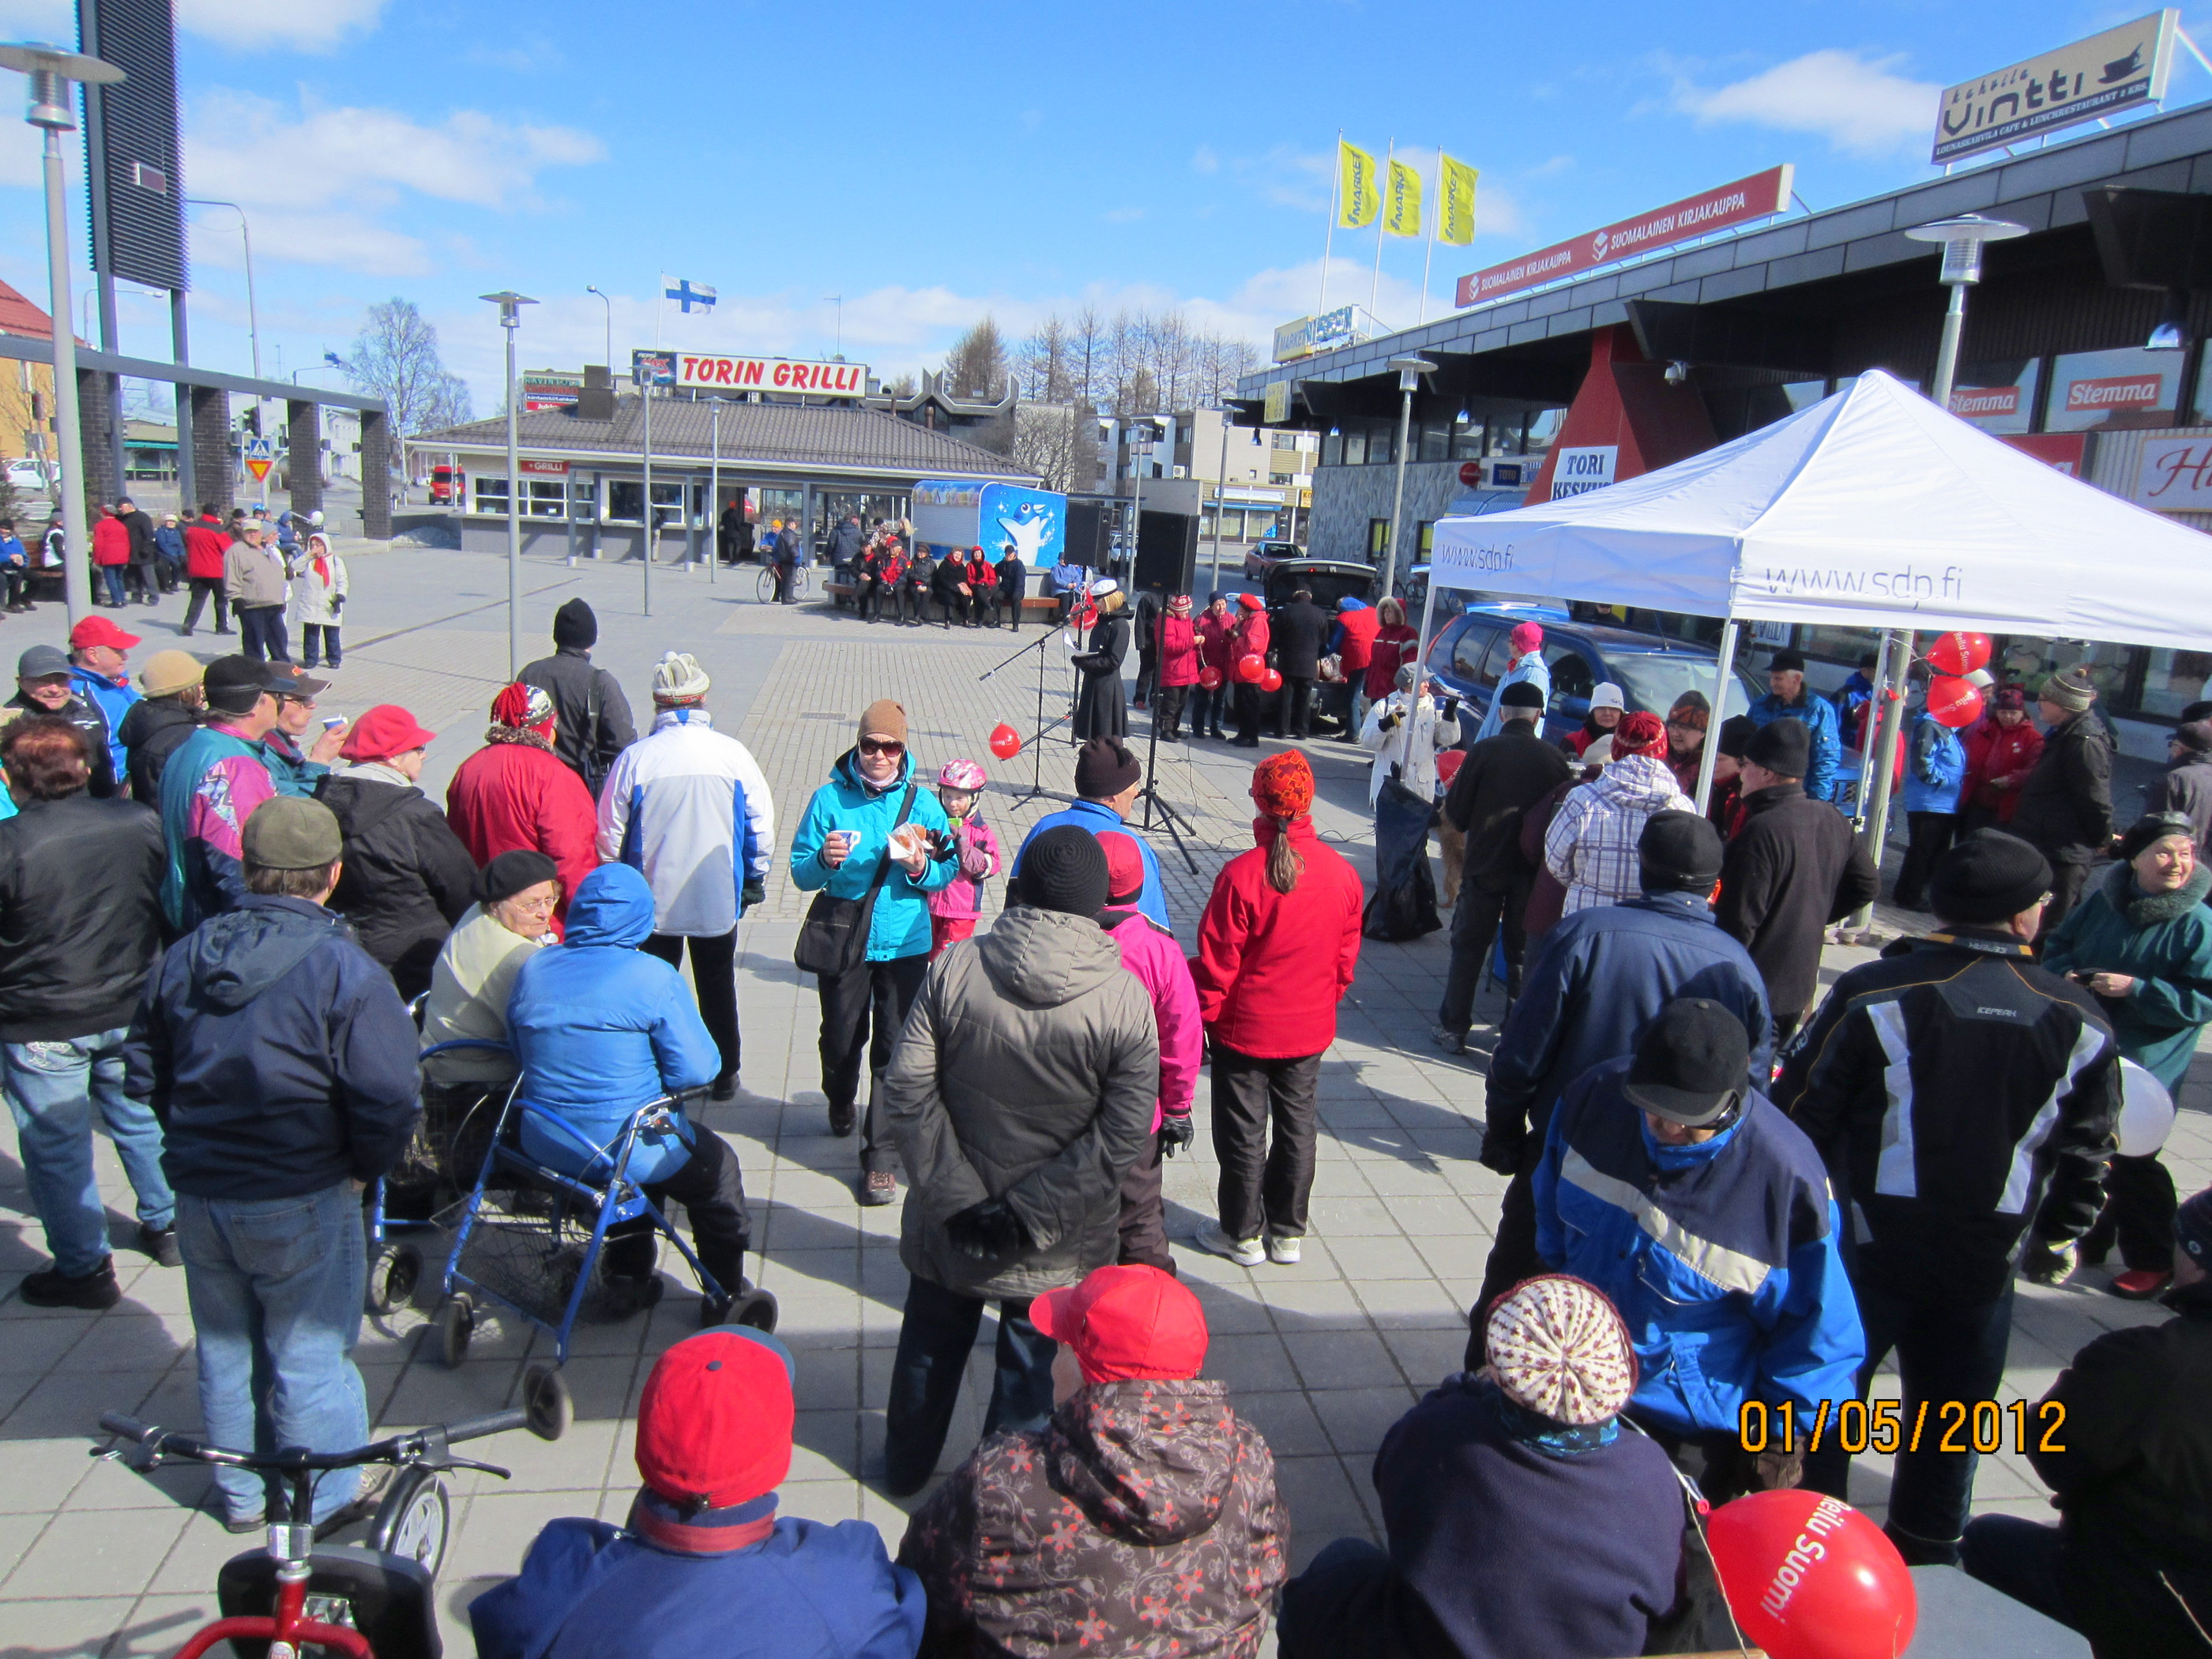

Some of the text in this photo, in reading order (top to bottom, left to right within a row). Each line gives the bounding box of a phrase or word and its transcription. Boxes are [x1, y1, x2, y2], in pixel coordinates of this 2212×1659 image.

[1951, 68, 2029, 106] kahvila
[1936, 129, 1998, 156] LOUNASKAHVILA
[1999, 122, 2020, 136] CAFE
[2021, 120, 2029, 129] &
[2030, 91, 2119, 126] LUNCHRESTAURANT
[1352, 151, 1363, 216] MARKET
[1394, 164, 1405, 222] MARKET
[1447, 167, 1458, 228] MARKET
[1611, 192, 1745, 250] SUOMALAINEN KIRJAKAUPPA
[1480, 250, 1571, 291] SUOMALAINEN KIRJAKAUPPA
[683, 358, 860, 391] TORIN GRILLI
[2069, 381, 2157, 405] Stemma
[534, 462, 562, 472] GRILLI
[1499, 469, 1517, 480] TOTO
[1567, 454, 1604, 476] TORI
[1442, 544, 1514, 575] www.sdp.fi
[1766, 564, 1963, 611] www.sdp.fi
[1977, 1006, 2017, 1018] ICEPEAK
[1760, 1495, 1853, 1624] Reilu Suomi
